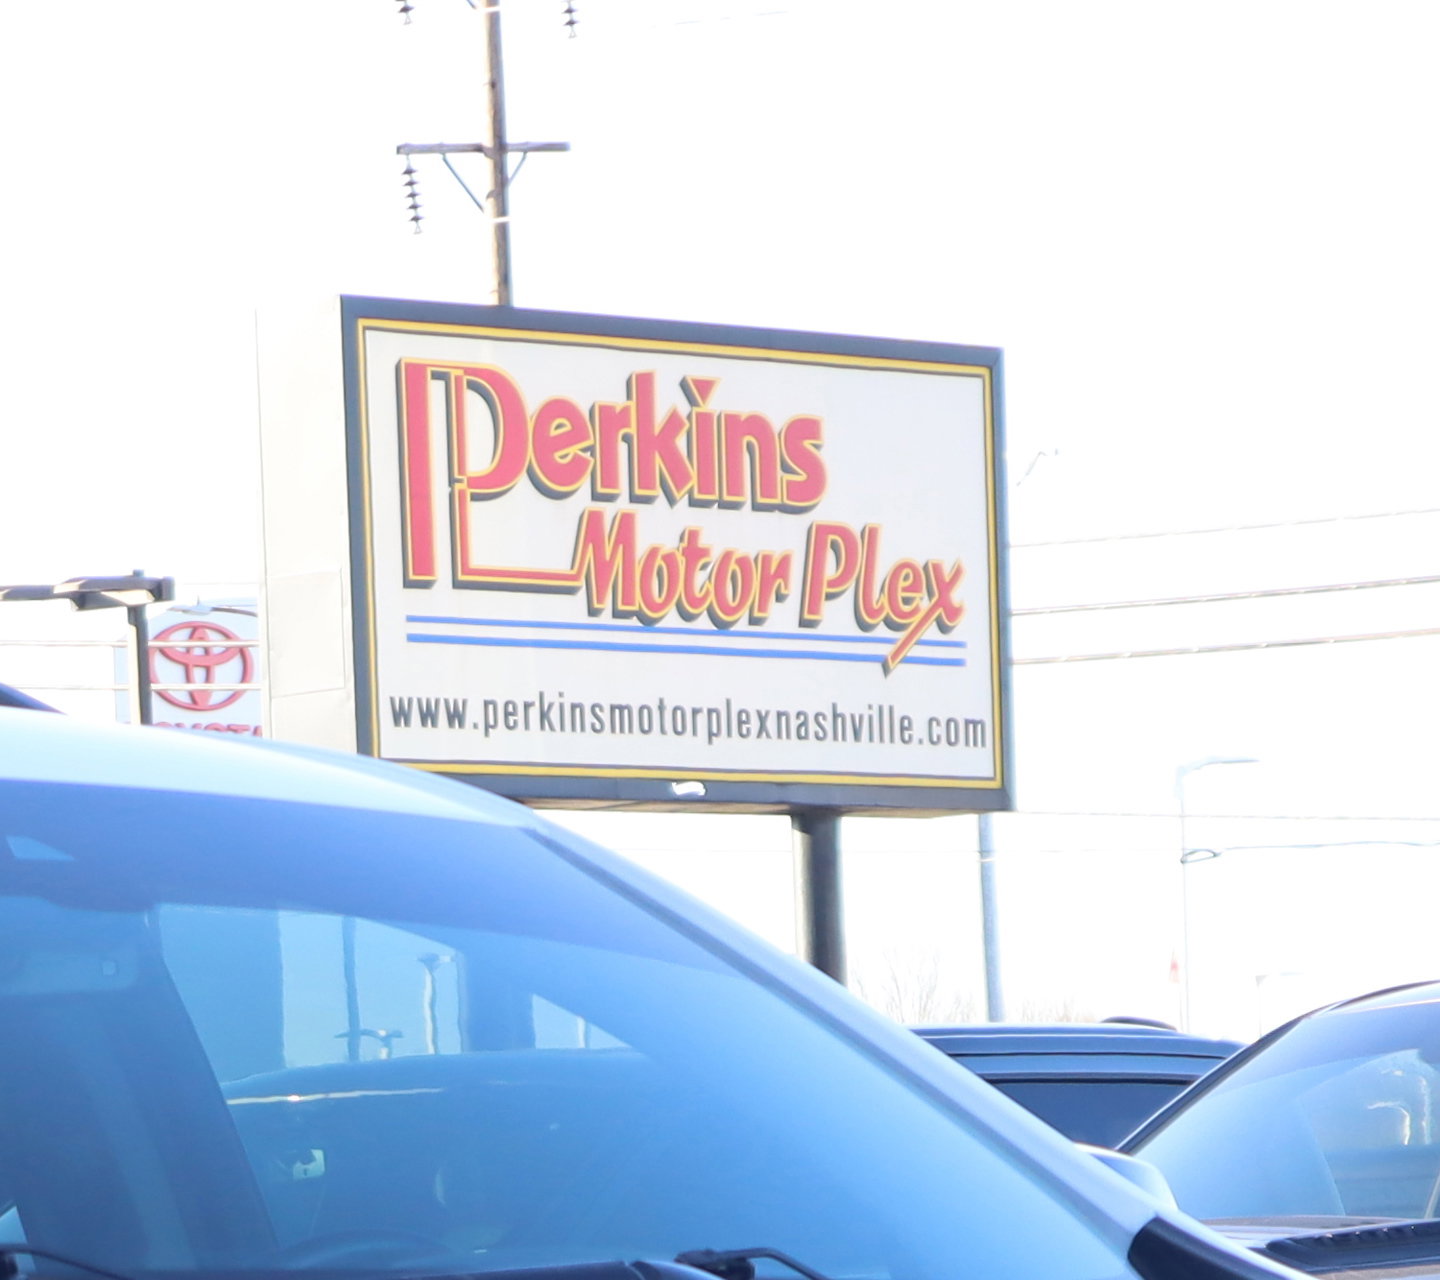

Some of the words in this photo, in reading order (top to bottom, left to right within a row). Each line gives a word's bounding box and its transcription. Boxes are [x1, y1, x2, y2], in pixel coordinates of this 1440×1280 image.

[395, 356, 829, 590] Perkins
[578, 506, 793, 628] Motor
[798, 520, 966, 678] Plex
[388, 691, 988, 750] www.perkinsmotorplexnashville.com
